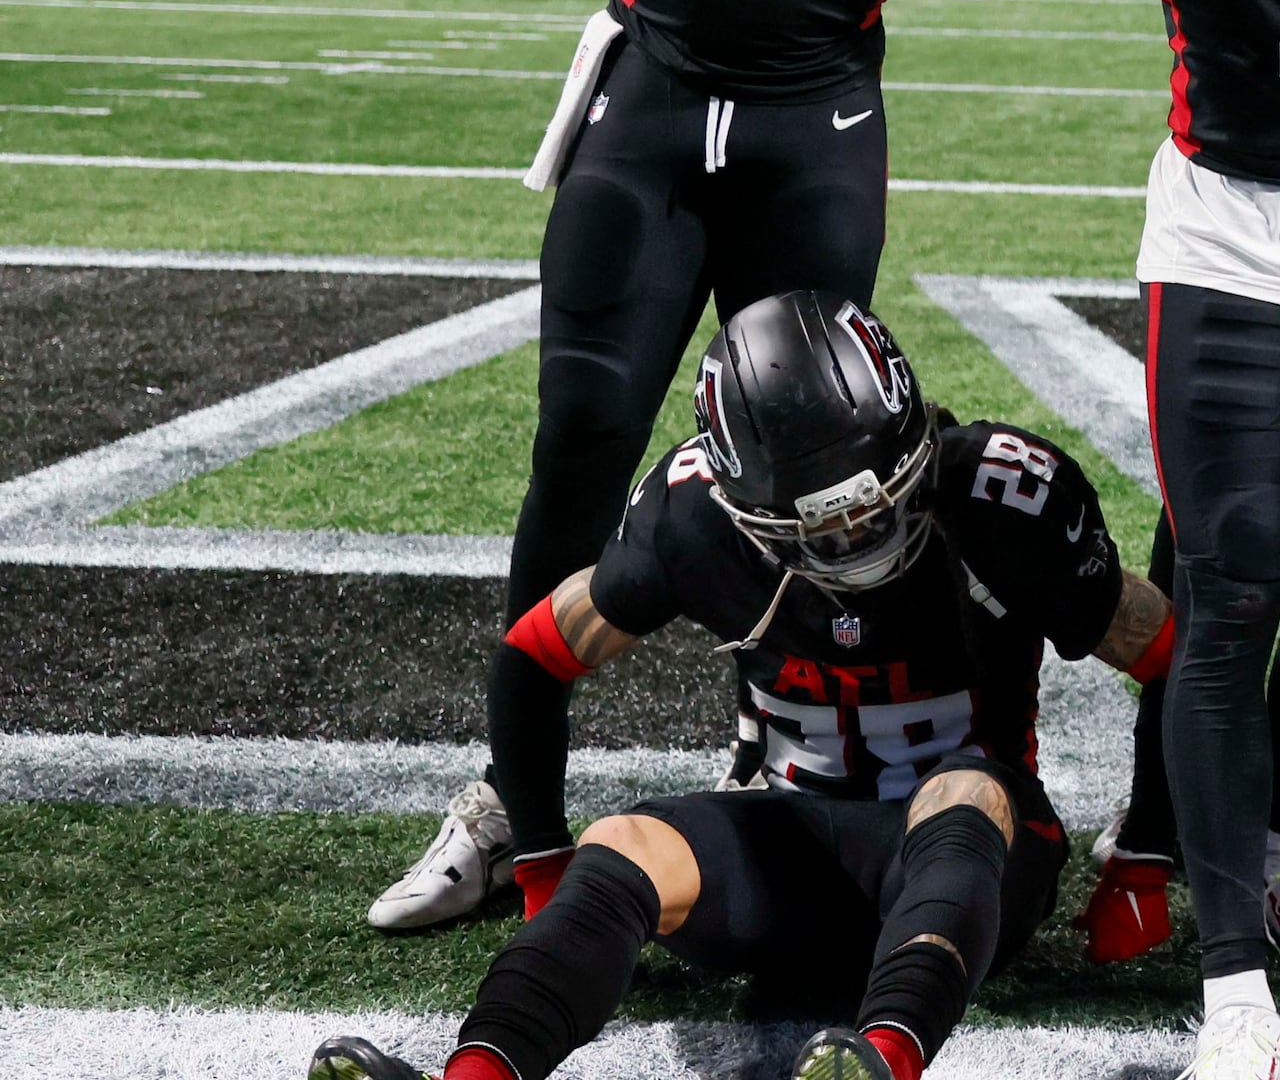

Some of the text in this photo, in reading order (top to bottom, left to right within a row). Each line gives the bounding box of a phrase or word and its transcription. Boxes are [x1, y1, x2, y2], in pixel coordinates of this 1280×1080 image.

[825, 494, 851, 508] ATL
[970, 432, 1063, 517] 28
[773, 653, 935, 707] ATL
